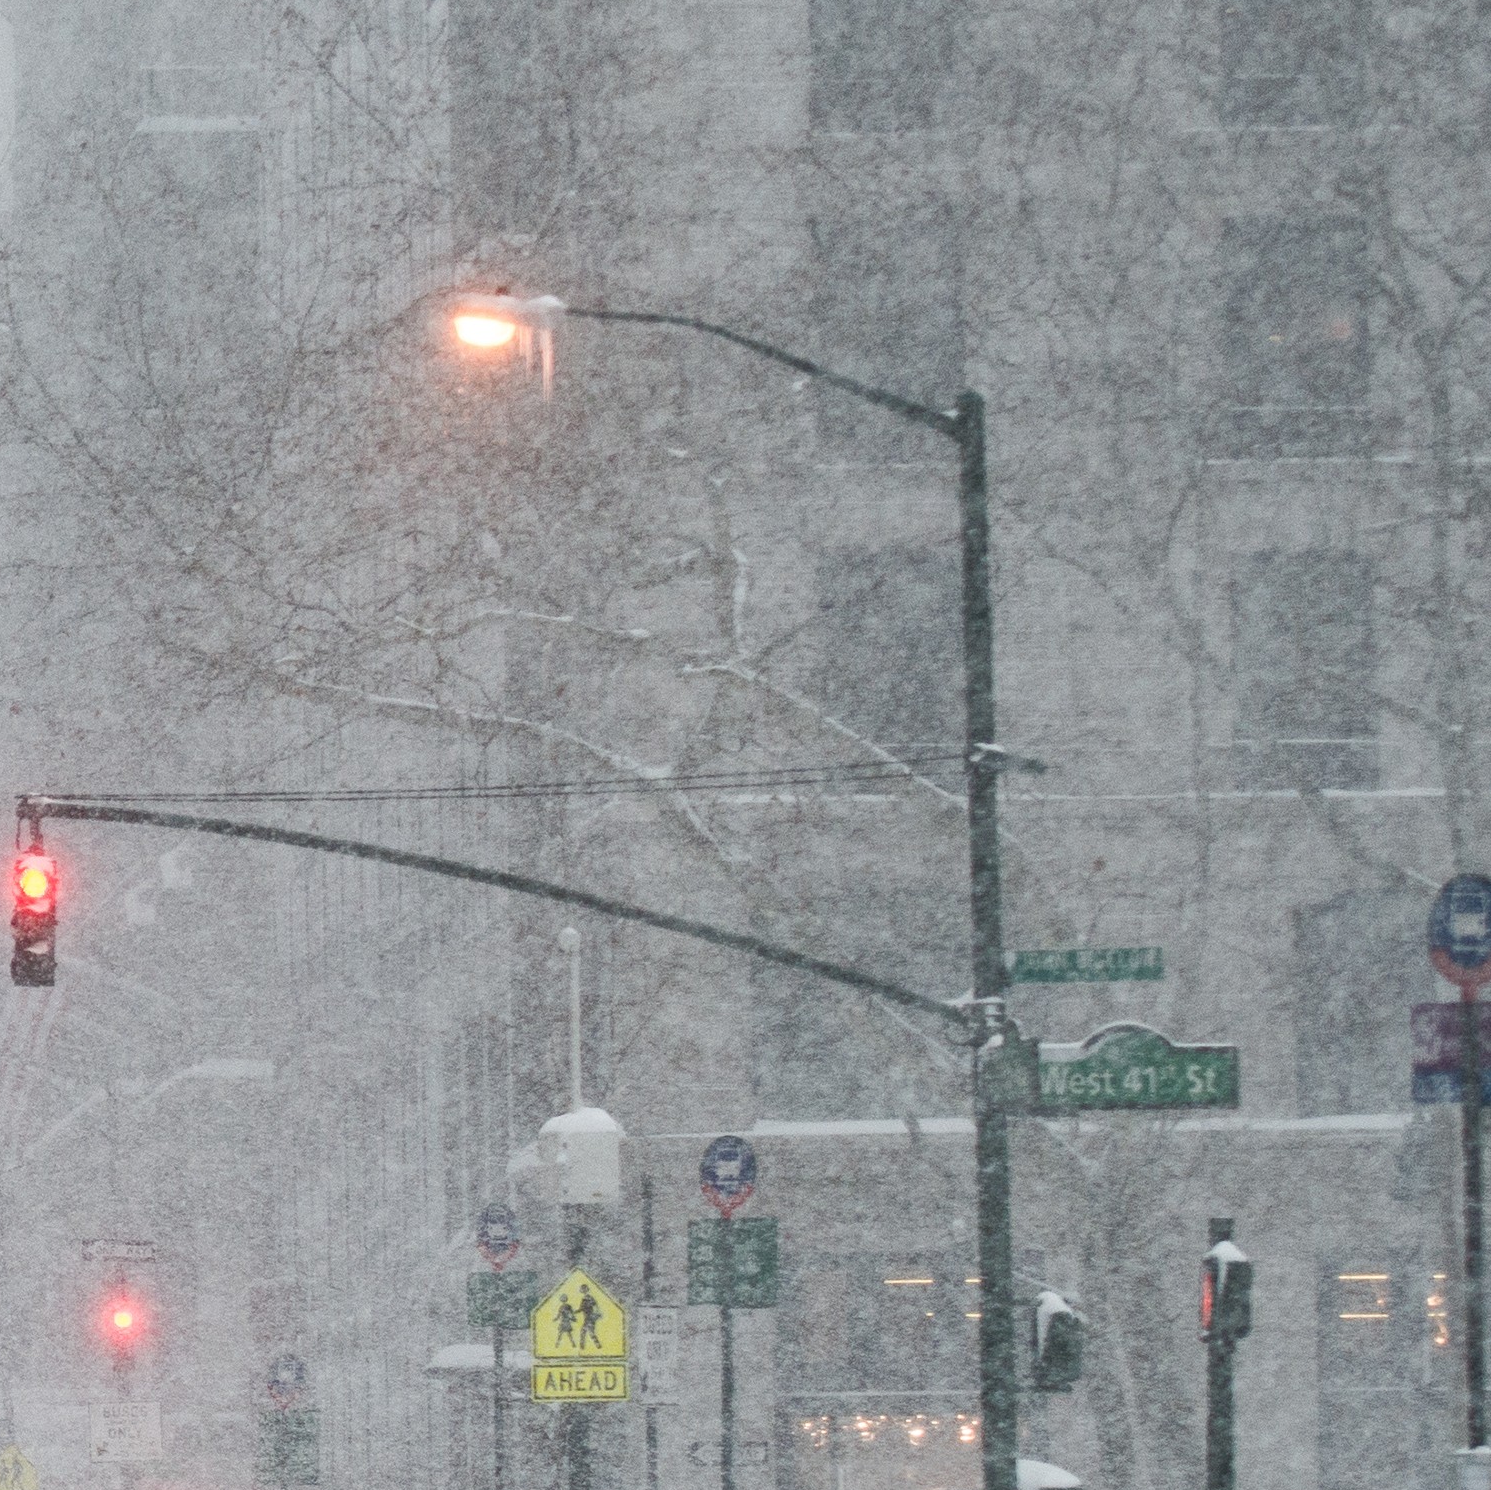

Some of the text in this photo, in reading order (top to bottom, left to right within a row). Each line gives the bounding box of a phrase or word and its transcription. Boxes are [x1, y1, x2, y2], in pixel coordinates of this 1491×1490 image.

[1039, 1064, 1116, 1096] West
[1186, 1064, 1217, 1094] St
[544, 1370, 617, 1392] AHEAD
